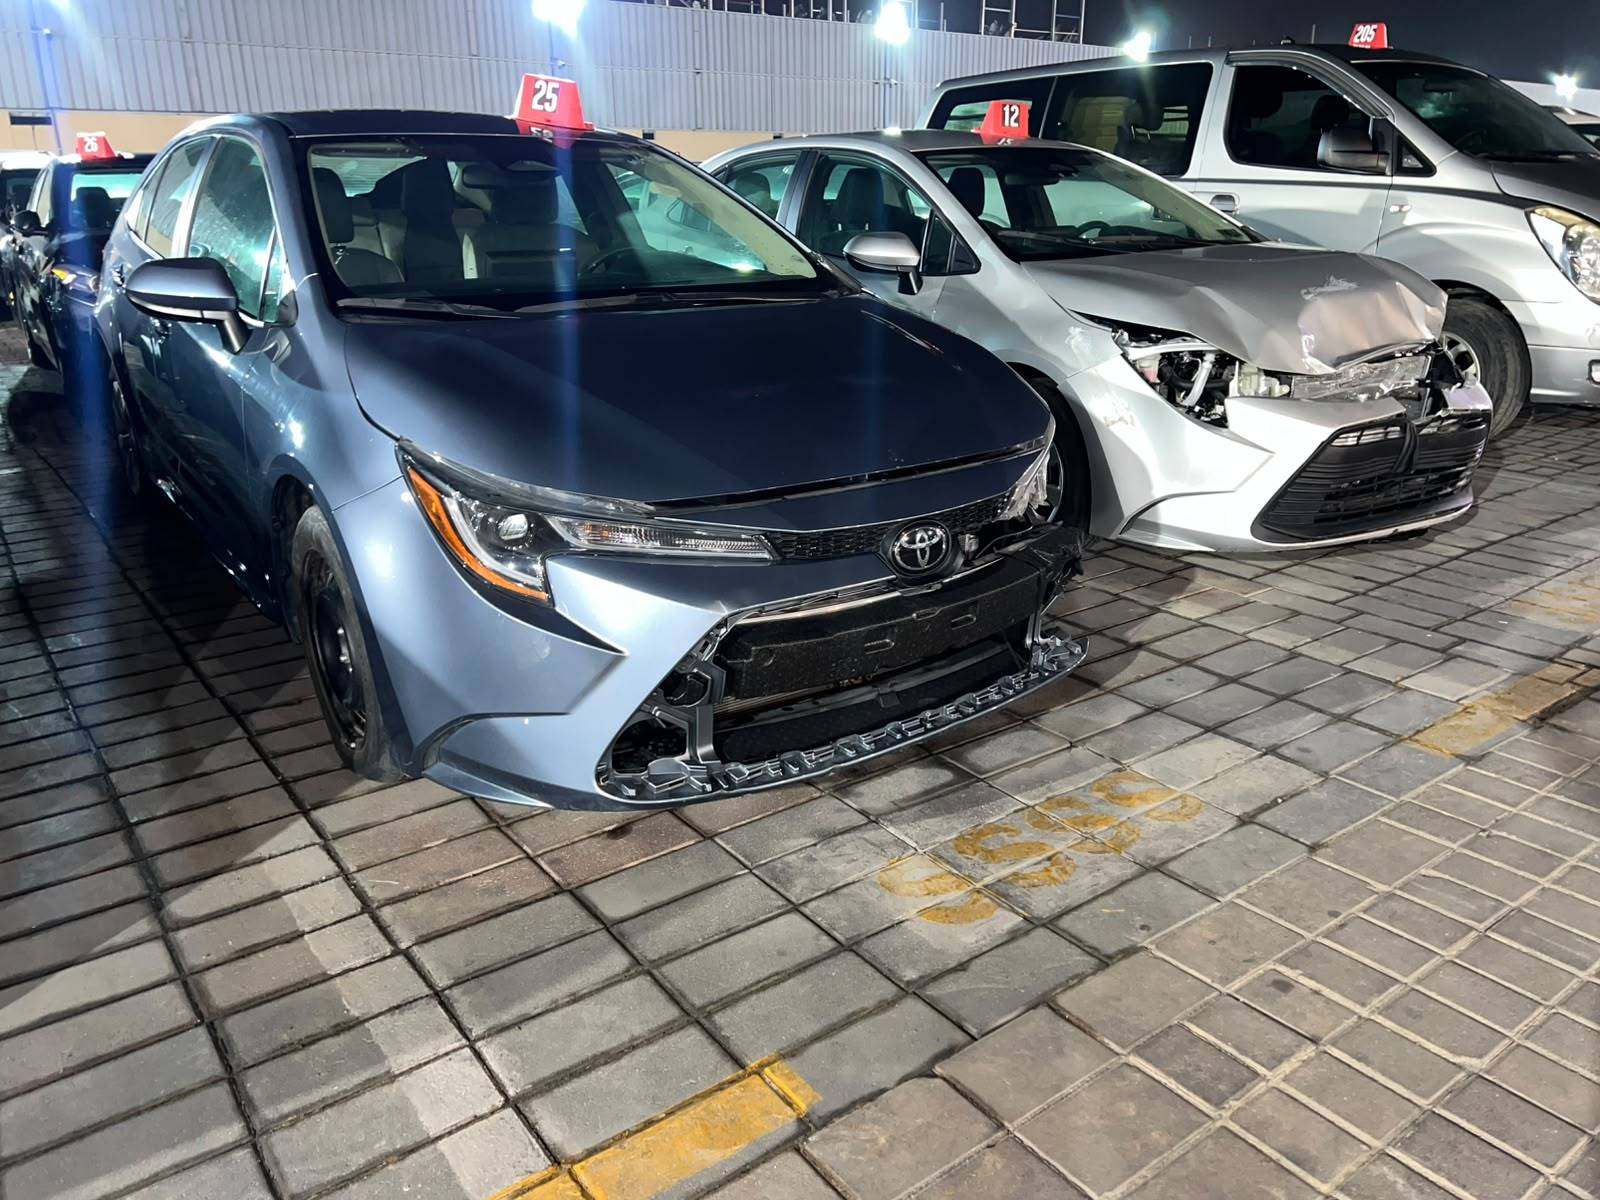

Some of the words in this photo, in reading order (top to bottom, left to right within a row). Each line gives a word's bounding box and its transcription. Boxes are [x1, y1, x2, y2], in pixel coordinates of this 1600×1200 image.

[1353, 24, 1378, 43] 205
[531, 79, 560, 112] 25
[1003, 104, 1020, 128] 12
